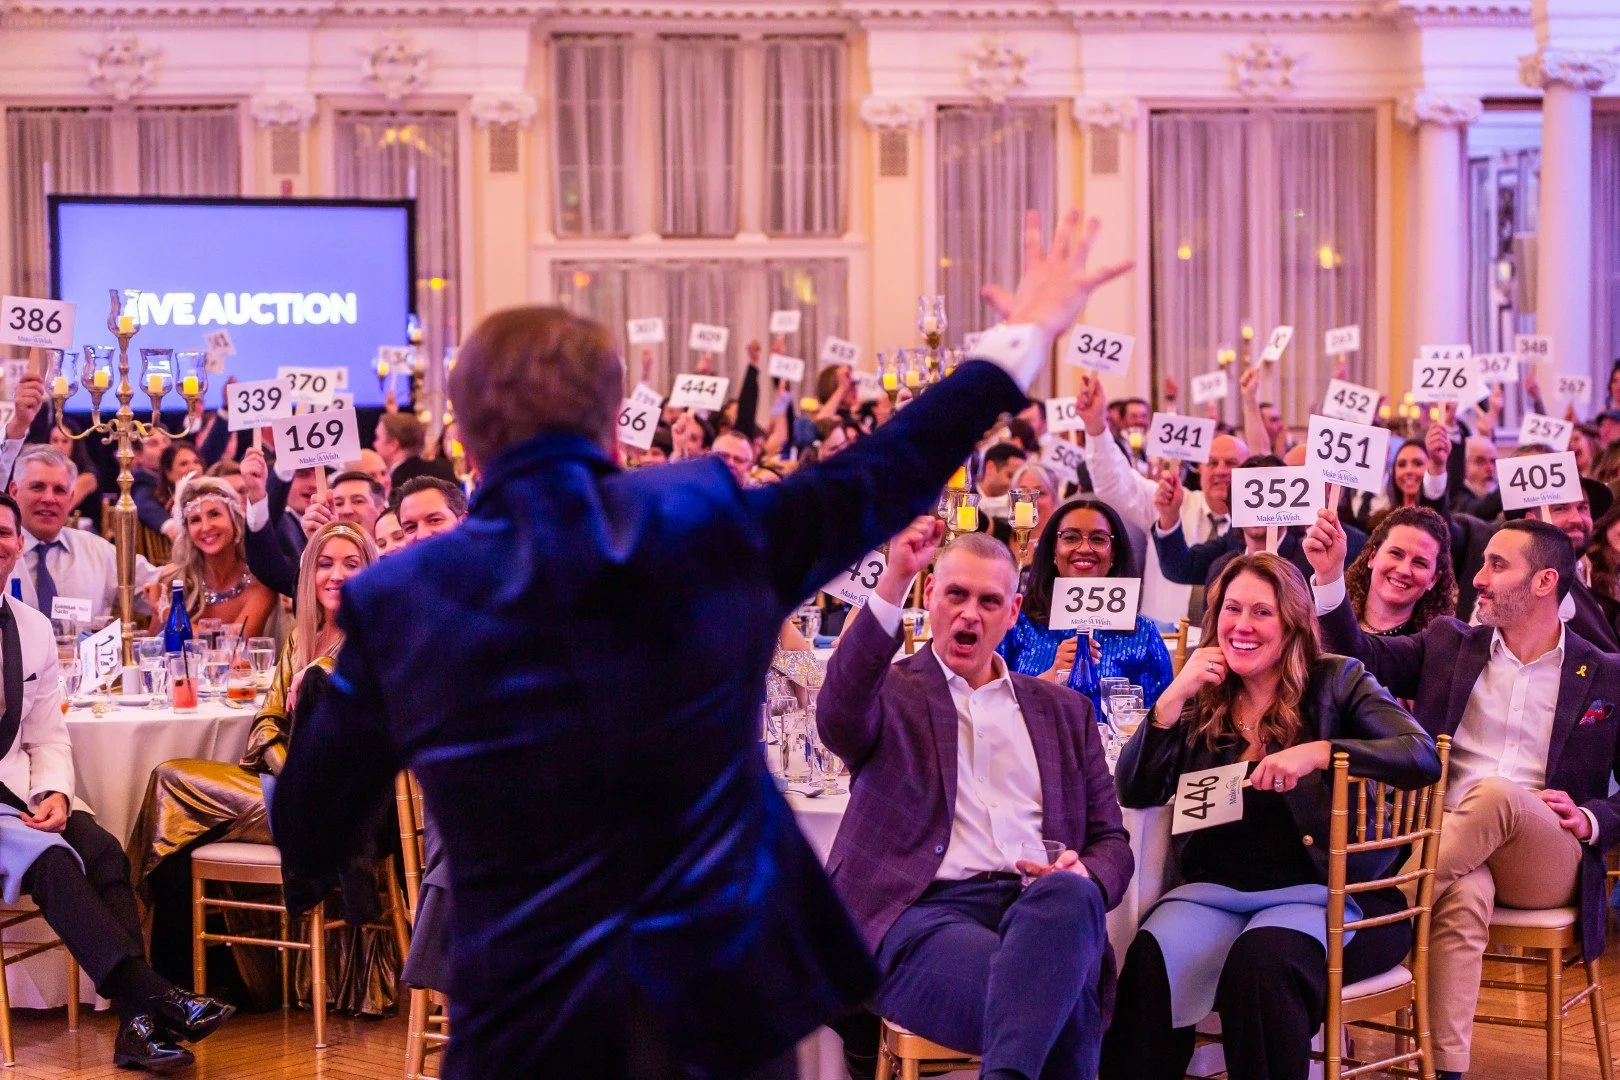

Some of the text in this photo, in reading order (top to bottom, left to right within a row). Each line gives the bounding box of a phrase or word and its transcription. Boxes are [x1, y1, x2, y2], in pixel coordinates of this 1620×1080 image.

[9, 307, 62, 333] 386
[198, 292, 357, 325] AUCTION
[1078, 334, 1122, 361] 342
[1421, 367, 1467, 388] 276
[1480, 356, 1510, 374] 367
[286, 373, 327, 393] 370
[681, 380, 718, 396] 444
[238, 387, 282, 413] 339
[1333, 389, 1370, 413] 452
[286, 420, 344, 452] 169
[1159, 423, 1201, 448] 341
[1529, 418, 1565, 439] 257
[1317, 429, 1370, 469] 351
[1510, 463, 1566, 491] 405
[1244, 478, 1310, 508] 352
[1256, 514, 1275, 522] Make
[1065, 587, 1126, 613] 358
[1182, 776, 1219, 819] 446
